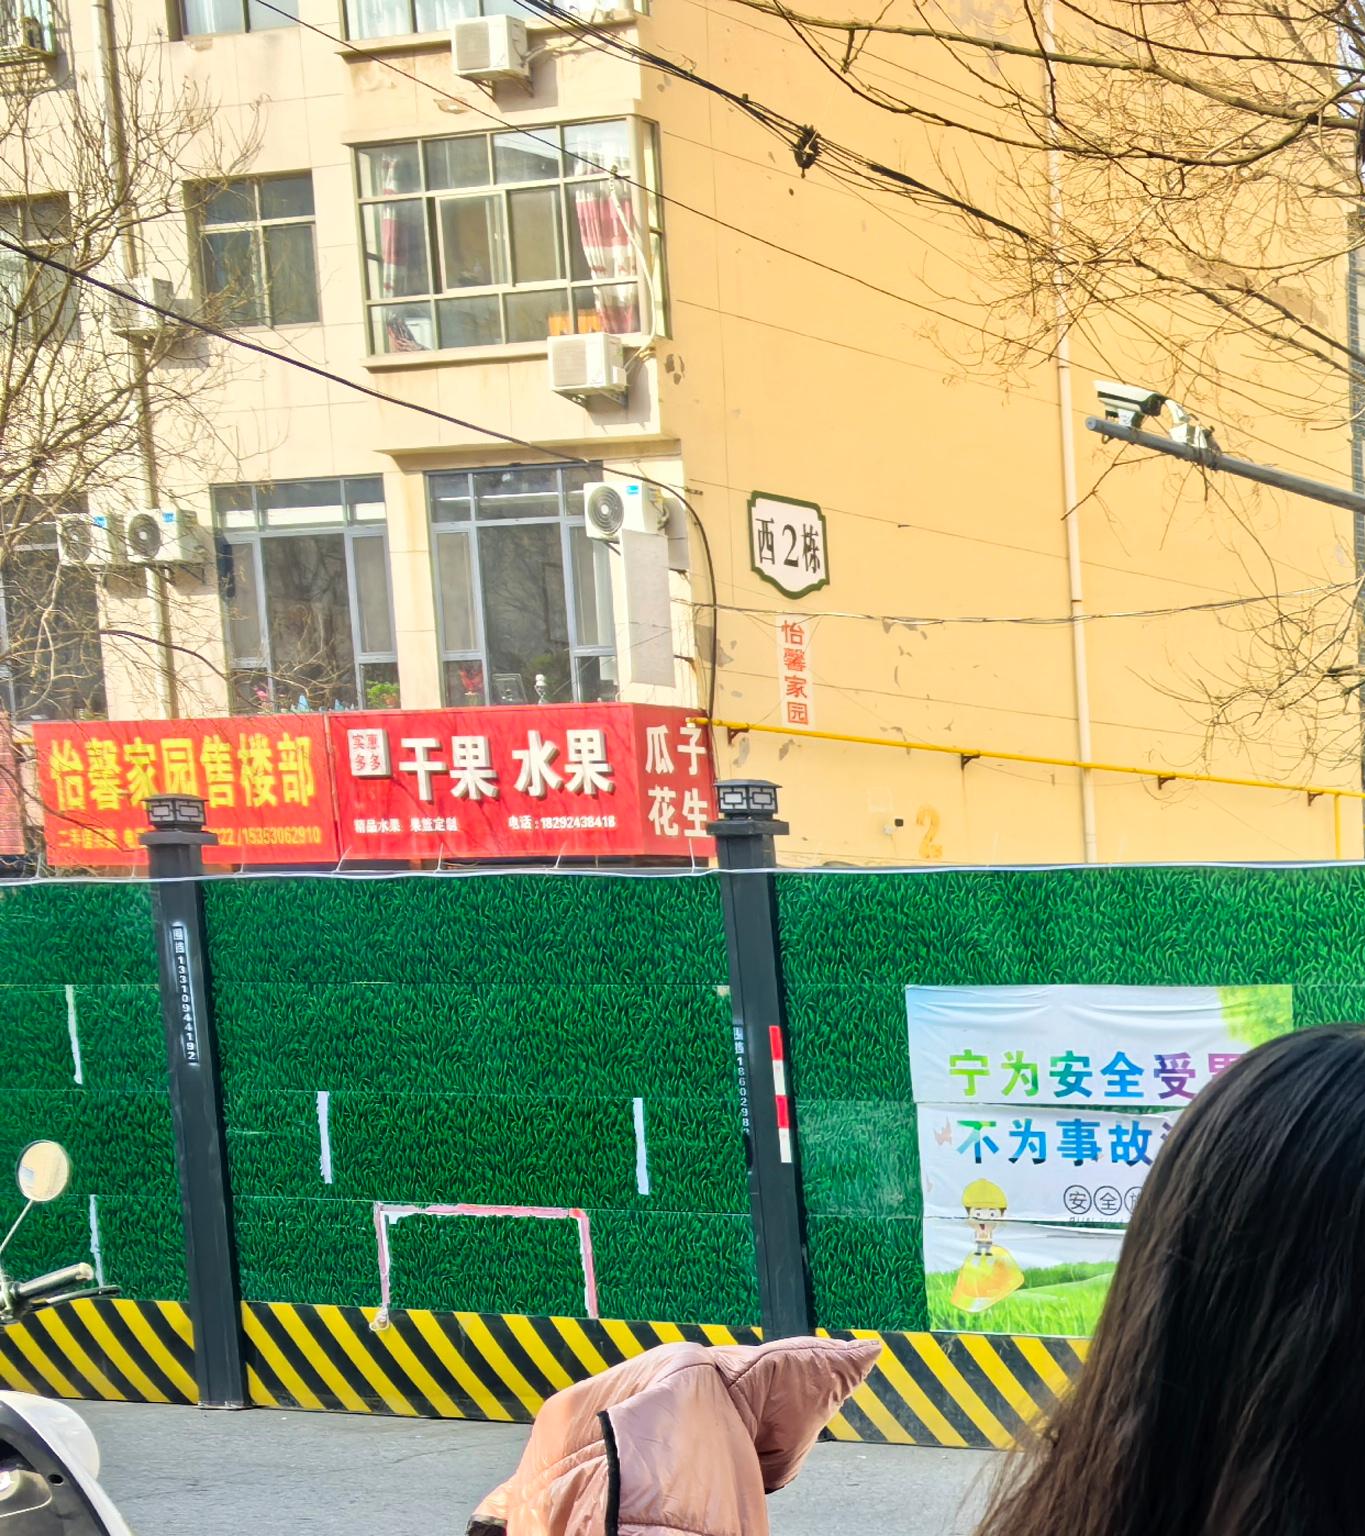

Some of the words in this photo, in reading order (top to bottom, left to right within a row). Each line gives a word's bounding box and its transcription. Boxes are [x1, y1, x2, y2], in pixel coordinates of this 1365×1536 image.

[755, 517, 822, 574] 西2栋
[780, 619, 810, 726] 怡馨家园
[50, 731, 317, 812] 怡馨家园售楼部
[354, 753, 382, 772] 多多
[399, 736, 499, 801] 干果
[511, 728, 617, 798] 水果
[645, 723, 707, 776] 瓜子
[648, 784, 712, 839] 花生
[956, 1117, 1180, 1167] 不为事故
